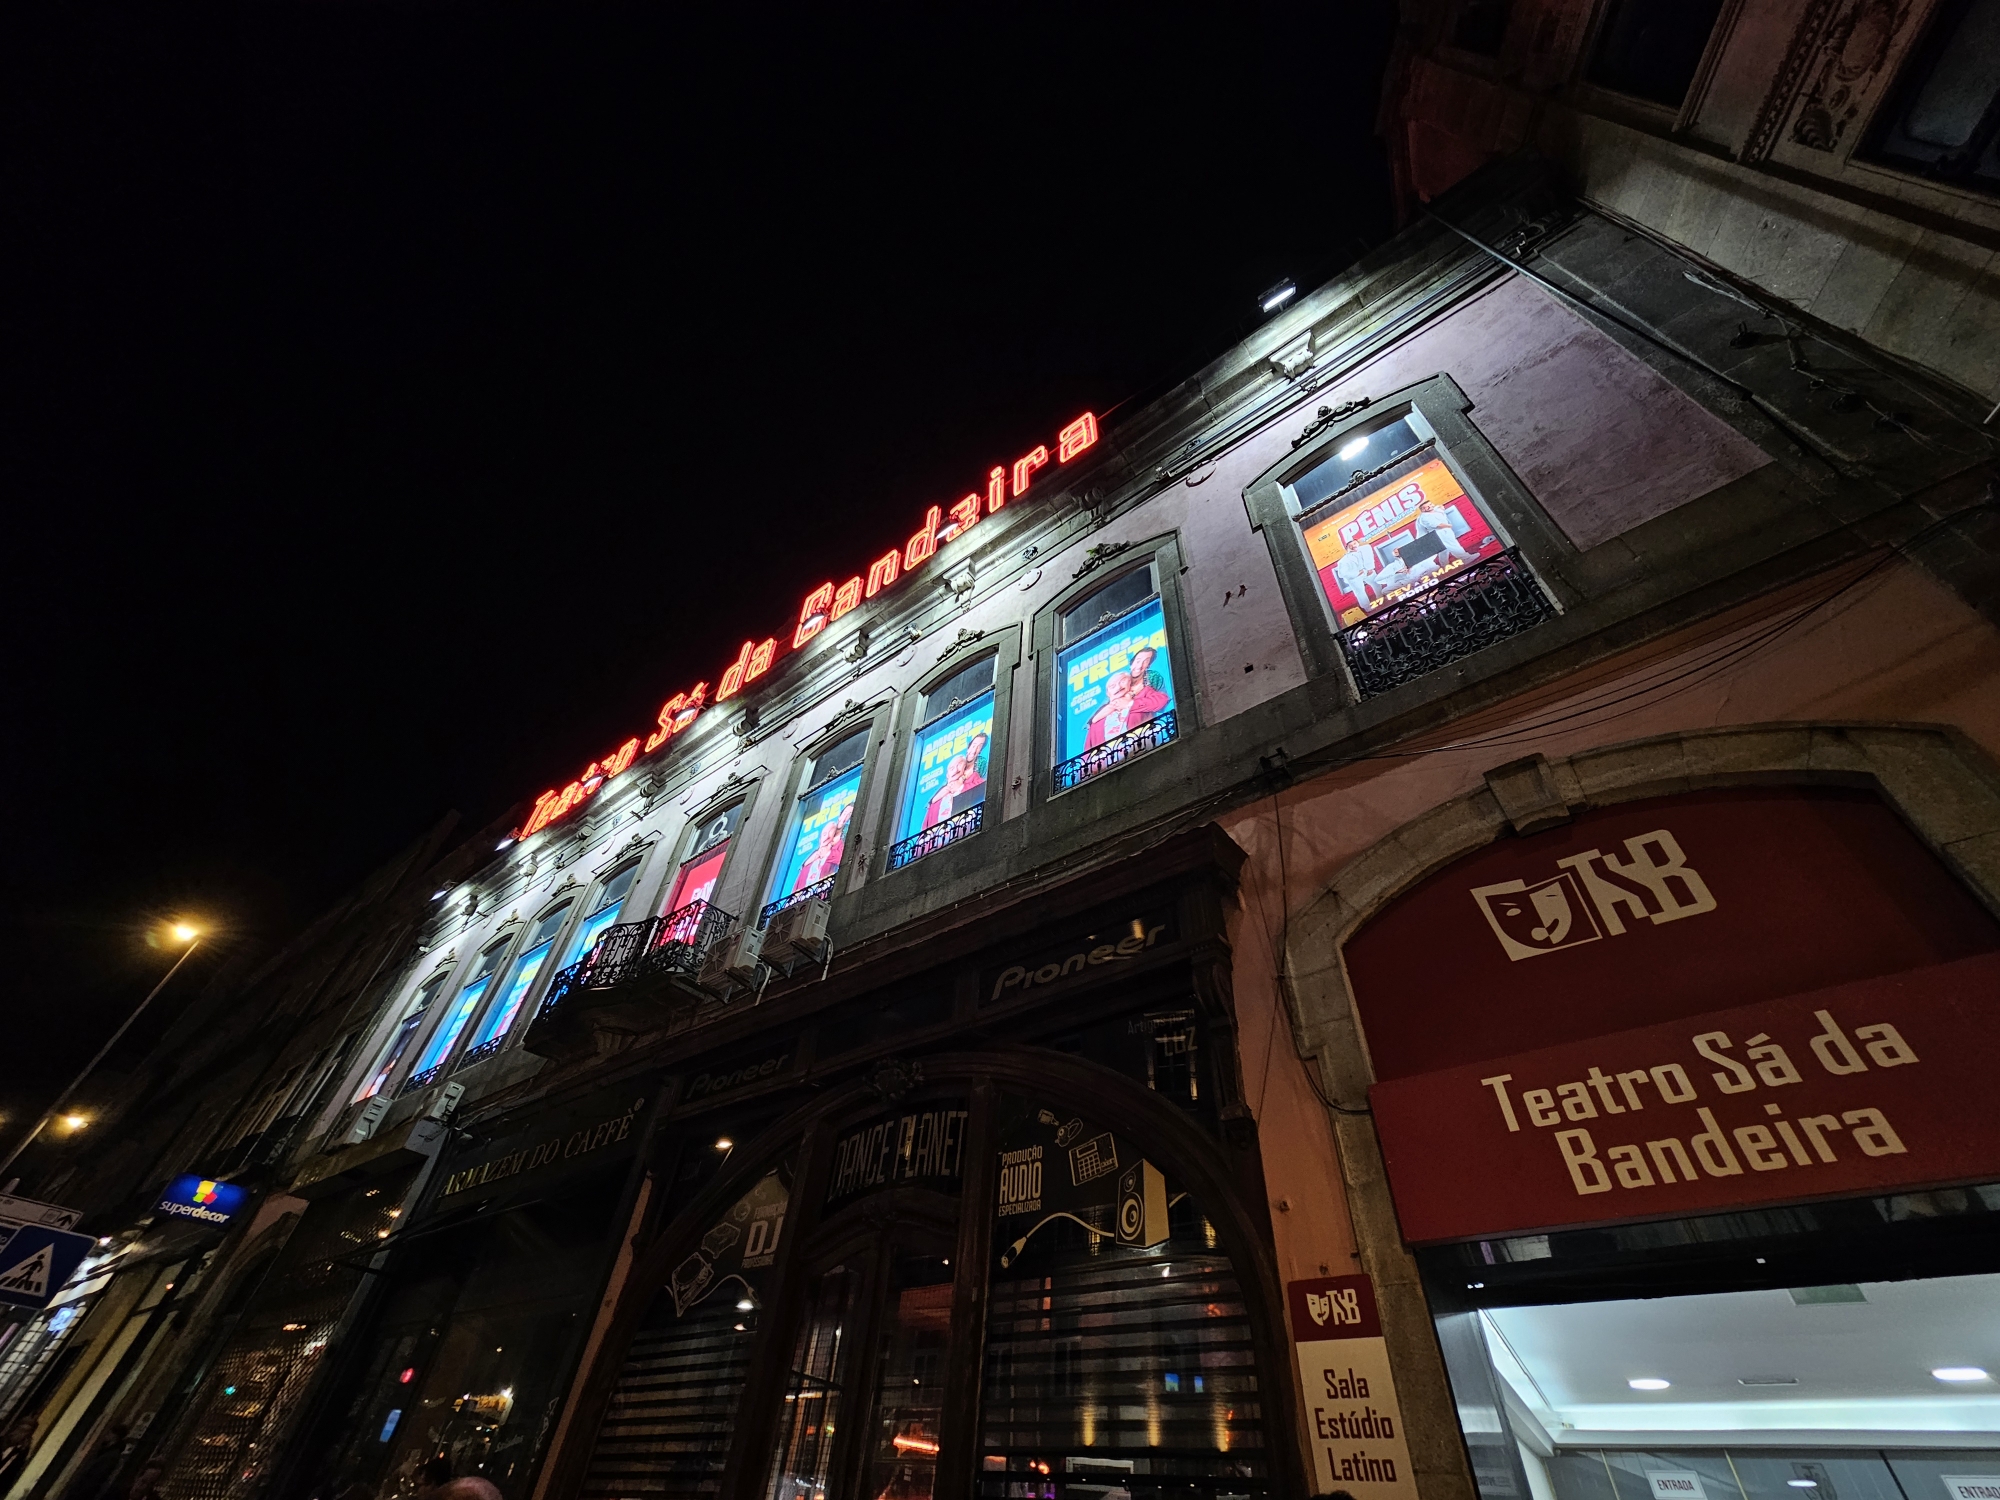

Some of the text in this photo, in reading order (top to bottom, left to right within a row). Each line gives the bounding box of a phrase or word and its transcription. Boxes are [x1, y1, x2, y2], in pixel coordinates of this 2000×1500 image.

[1338, 481, 1426, 548] PÉNIS
[716, 638, 777, 701] da
[792, 411, 1099, 650] Bandeira
[1369, 597, 1385, 610] 27
[1387, 583, 1412, 601] FEV
[1420, 575, 1431, 584] 2
[1432, 559, 1464, 578] MAR
[1397, 578, 1440, 602] PORTO
[1069, 629, 1166, 692] TRETA
[1070, 637, 1131, 677] AMIGOS
[992, 924, 1166, 1001] Pioneer
[1163, 1026, 1199, 1057] LUZ
[686, 1054, 789, 1100] Pioneer
[1481, 1009, 1920, 1132] Teatro Sá da
[527, 1138, 560, 1170] DO
[827, 1110, 969, 1204] DANCE PLANET
[1001, 1144, 1043, 1167] PRODUÇÃO
[1555, 1103, 1908, 1196] Bandeira
[158, 1200, 231, 1224] superdecor
[998, 1199, 1042, 1218] ESPECIALIZADA
[743, 1215, 786, 1258] DJ
[1323, 1368, 1370, 1399] Sala
[1314, 1406, 1395, 1439] Estúdio
[1327, 1447, 1397, 1483] Latino
[1656, 1479, 1695, 1491] ENTRADA
[1957, 1486, 2000, 1499] ENTRAD
